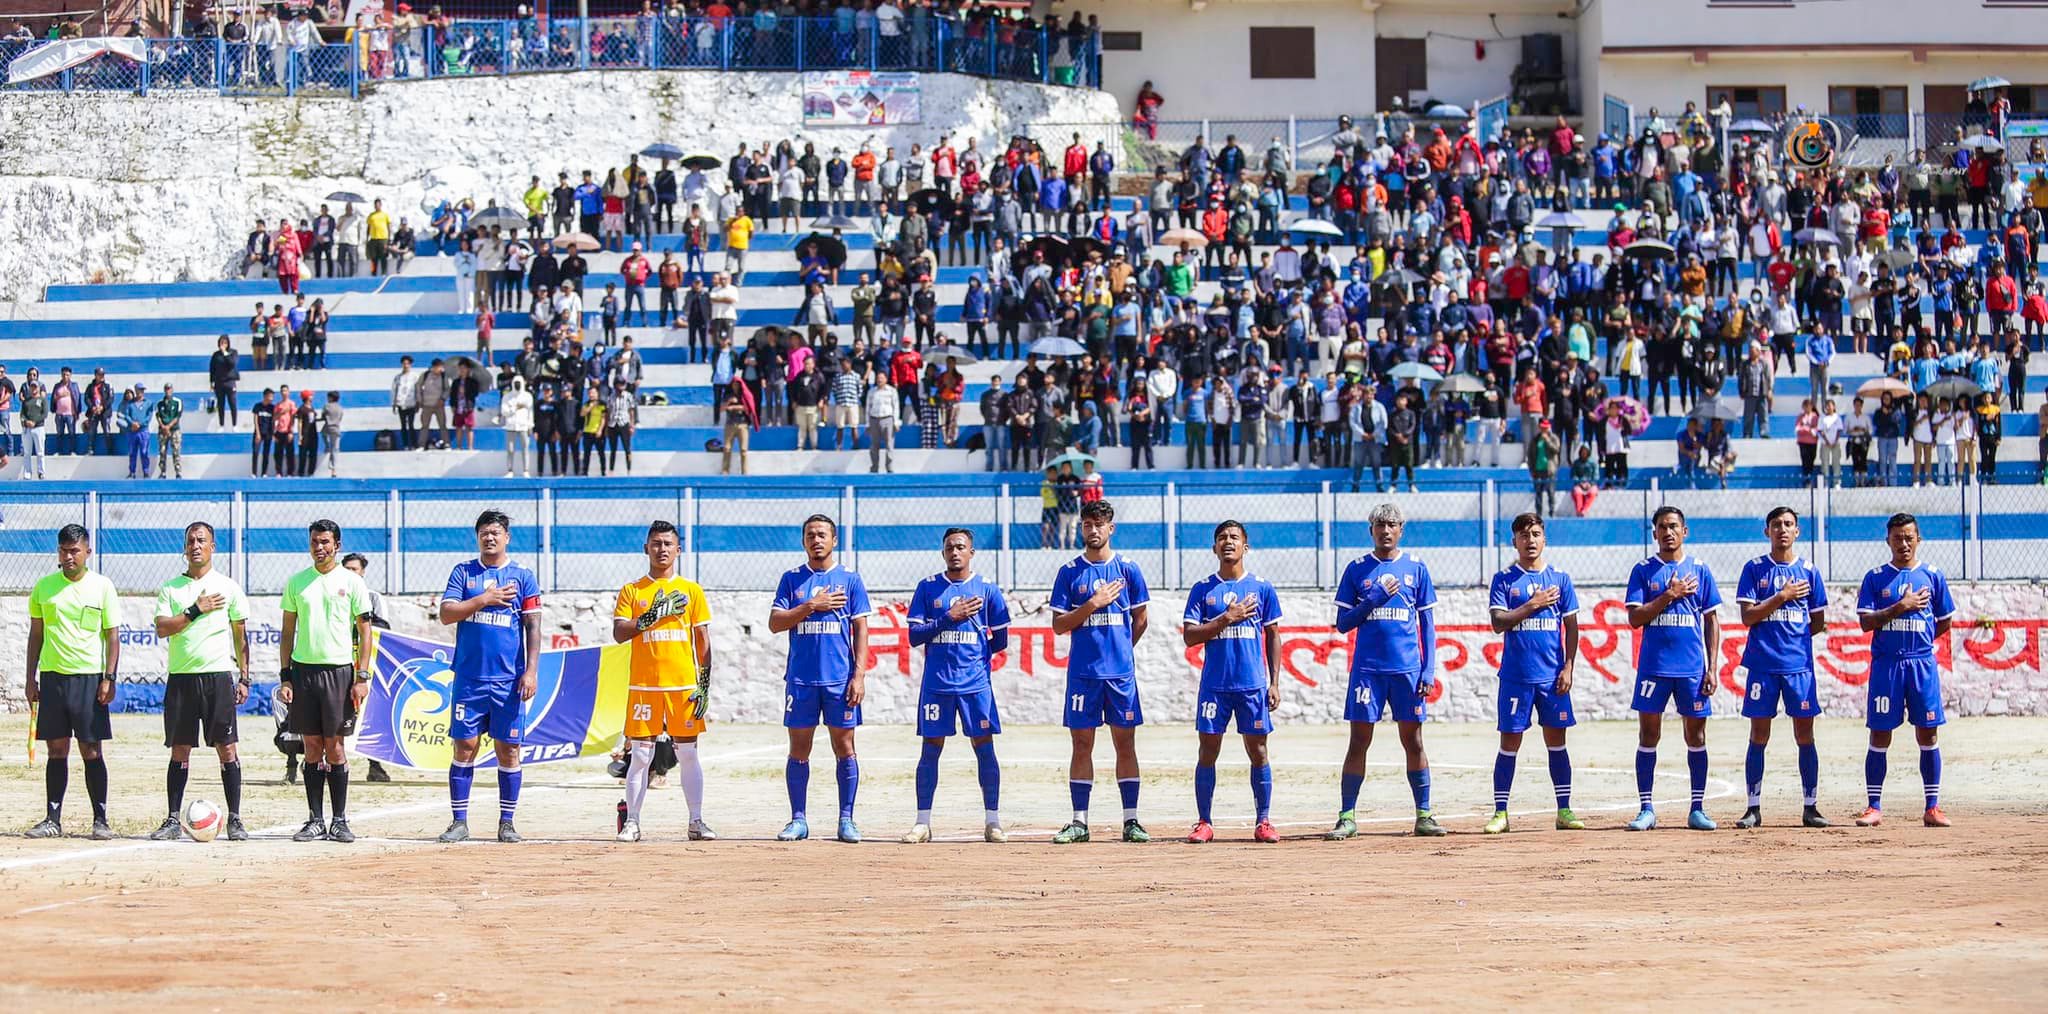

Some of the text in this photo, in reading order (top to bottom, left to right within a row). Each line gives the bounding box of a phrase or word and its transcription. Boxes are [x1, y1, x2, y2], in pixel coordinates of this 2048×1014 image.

[475, 611, 493, 626] SHREE
[1090, 613, 1108, 626] SHREE
[1373, 608, 1392, 620] SHREE
[1660, 614, 1678, 627] SHREE
[805, 621, 823, 634] SHREE
[1521, 618, 1540, 631] SHREE
[1891, 619, 1908, 632] SHREE
[651, 629, 670, 642] SHREE
[941, 631, 960, 644] SHREE
[1220, 627, 1238, 639] SHREE
[1354, 686, 1371, 704] 14
[1640, 680, 1656, 698] 17
[1751, 683, 1761, 700] 8
[1071, 694, 1084, 712] 11
[1201, 701, 1217, 719] 18
[1510, 697, 1518, 715] 7
[1874, 696, 1890, 714] 10
[455, 704, 465, 721] 5
[633, 703, 651, 721] 25
[923, 703, 940, 721] 13
[404, 719, 429, 731] MY
[407, 732, 445, 746] FAIR
[519, 742, 577, 762] FIFA
